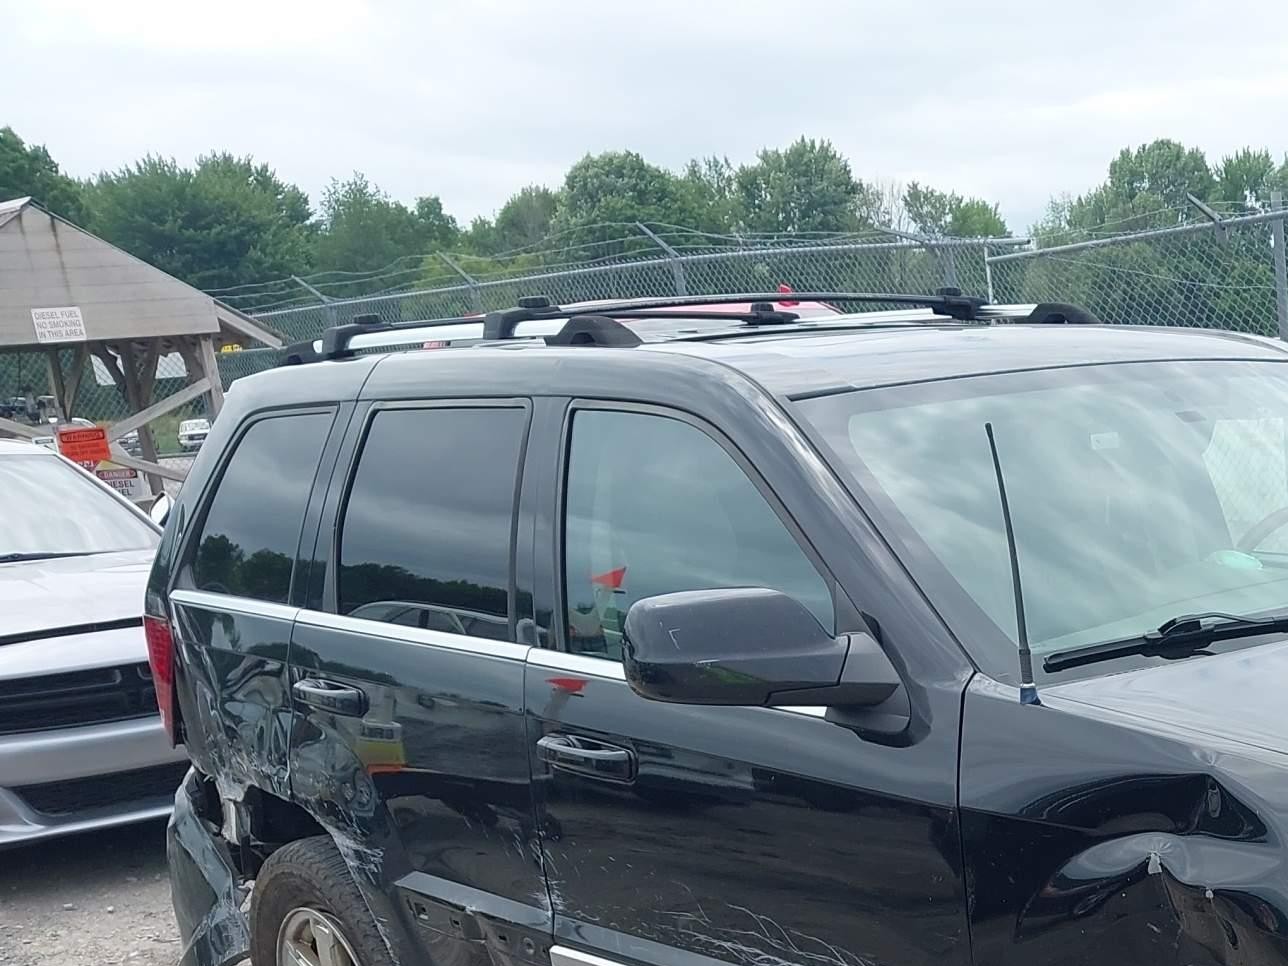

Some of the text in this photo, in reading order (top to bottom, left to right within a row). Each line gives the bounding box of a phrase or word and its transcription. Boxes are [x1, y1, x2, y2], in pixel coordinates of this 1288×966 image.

[34, 311, 57, 319] DIESEL
[36, 320, 81, 328] NO SMOKING
[39, 330, 47, 338] IN
[65, 328, 85, 337] AREA
